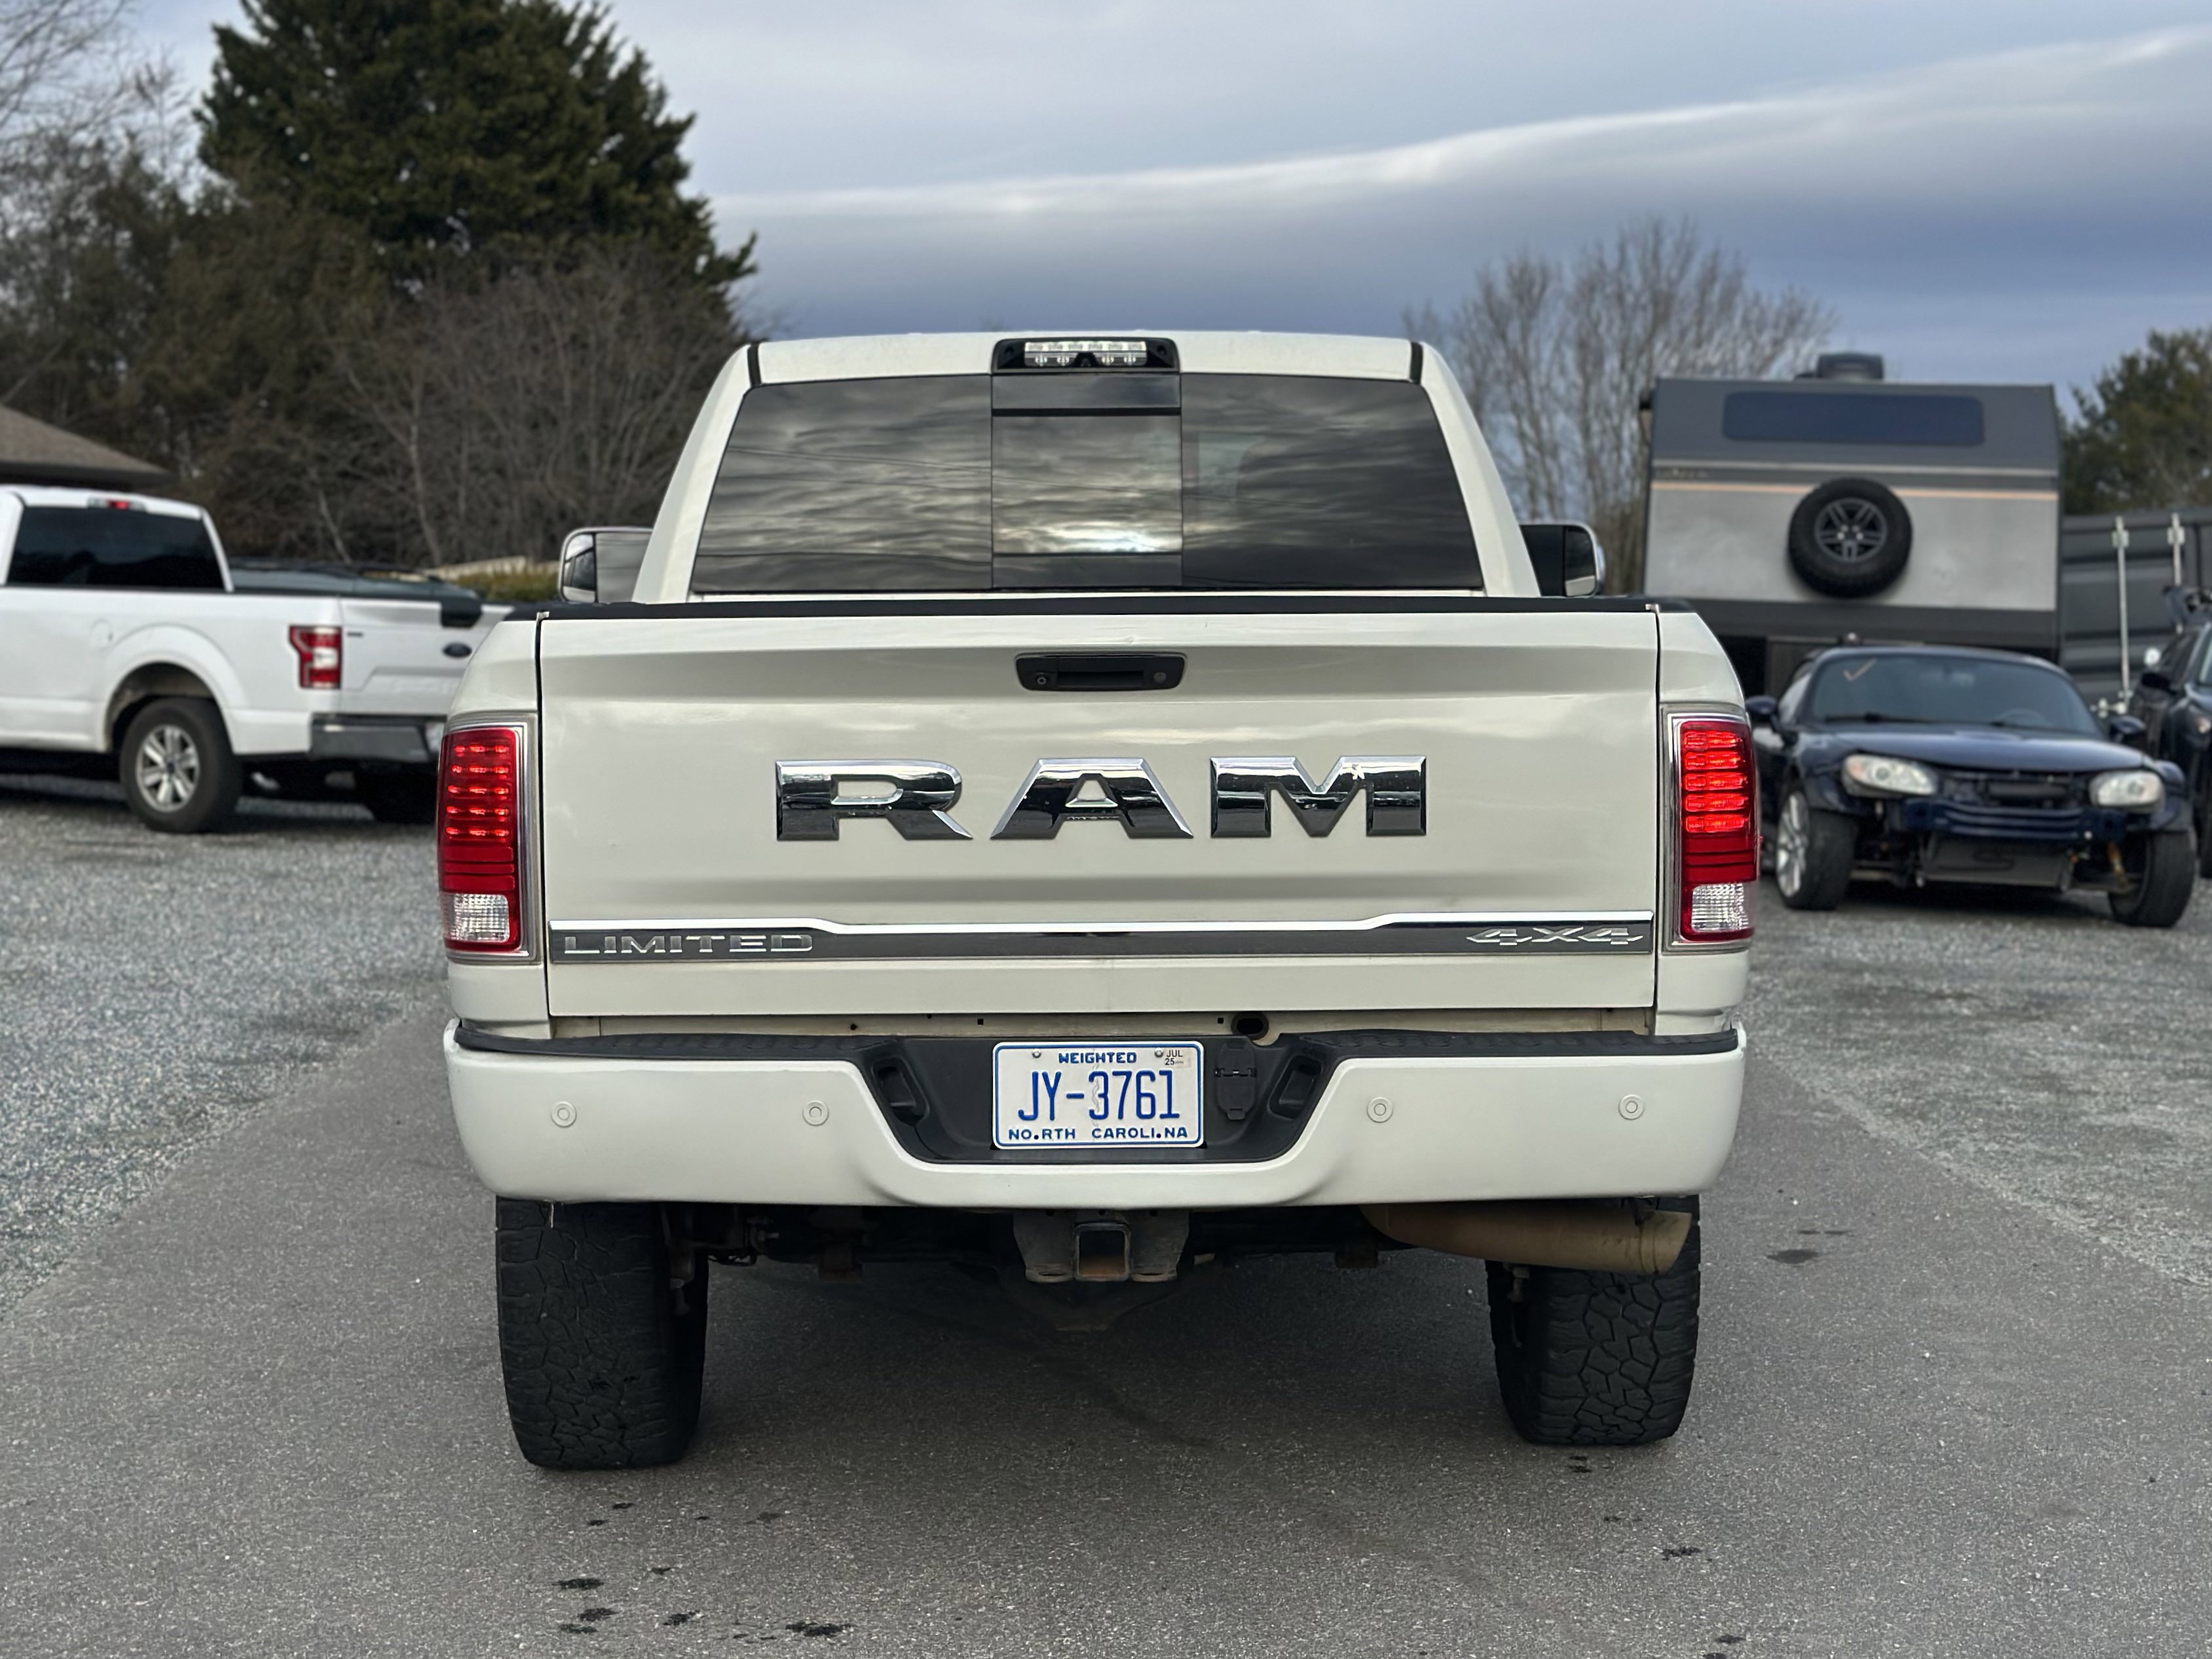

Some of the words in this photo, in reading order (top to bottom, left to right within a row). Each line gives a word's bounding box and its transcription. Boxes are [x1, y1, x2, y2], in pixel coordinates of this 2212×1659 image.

[776, 756, 1427, 841] RAM
[565, 935, 813, 954] LIMITED
[1059, 1052, 1137, 1064] WEIGHTED
[1167, 1049, 1183, 1058] JUL
[1018, 1070, 1180, 1121] JY-3761
